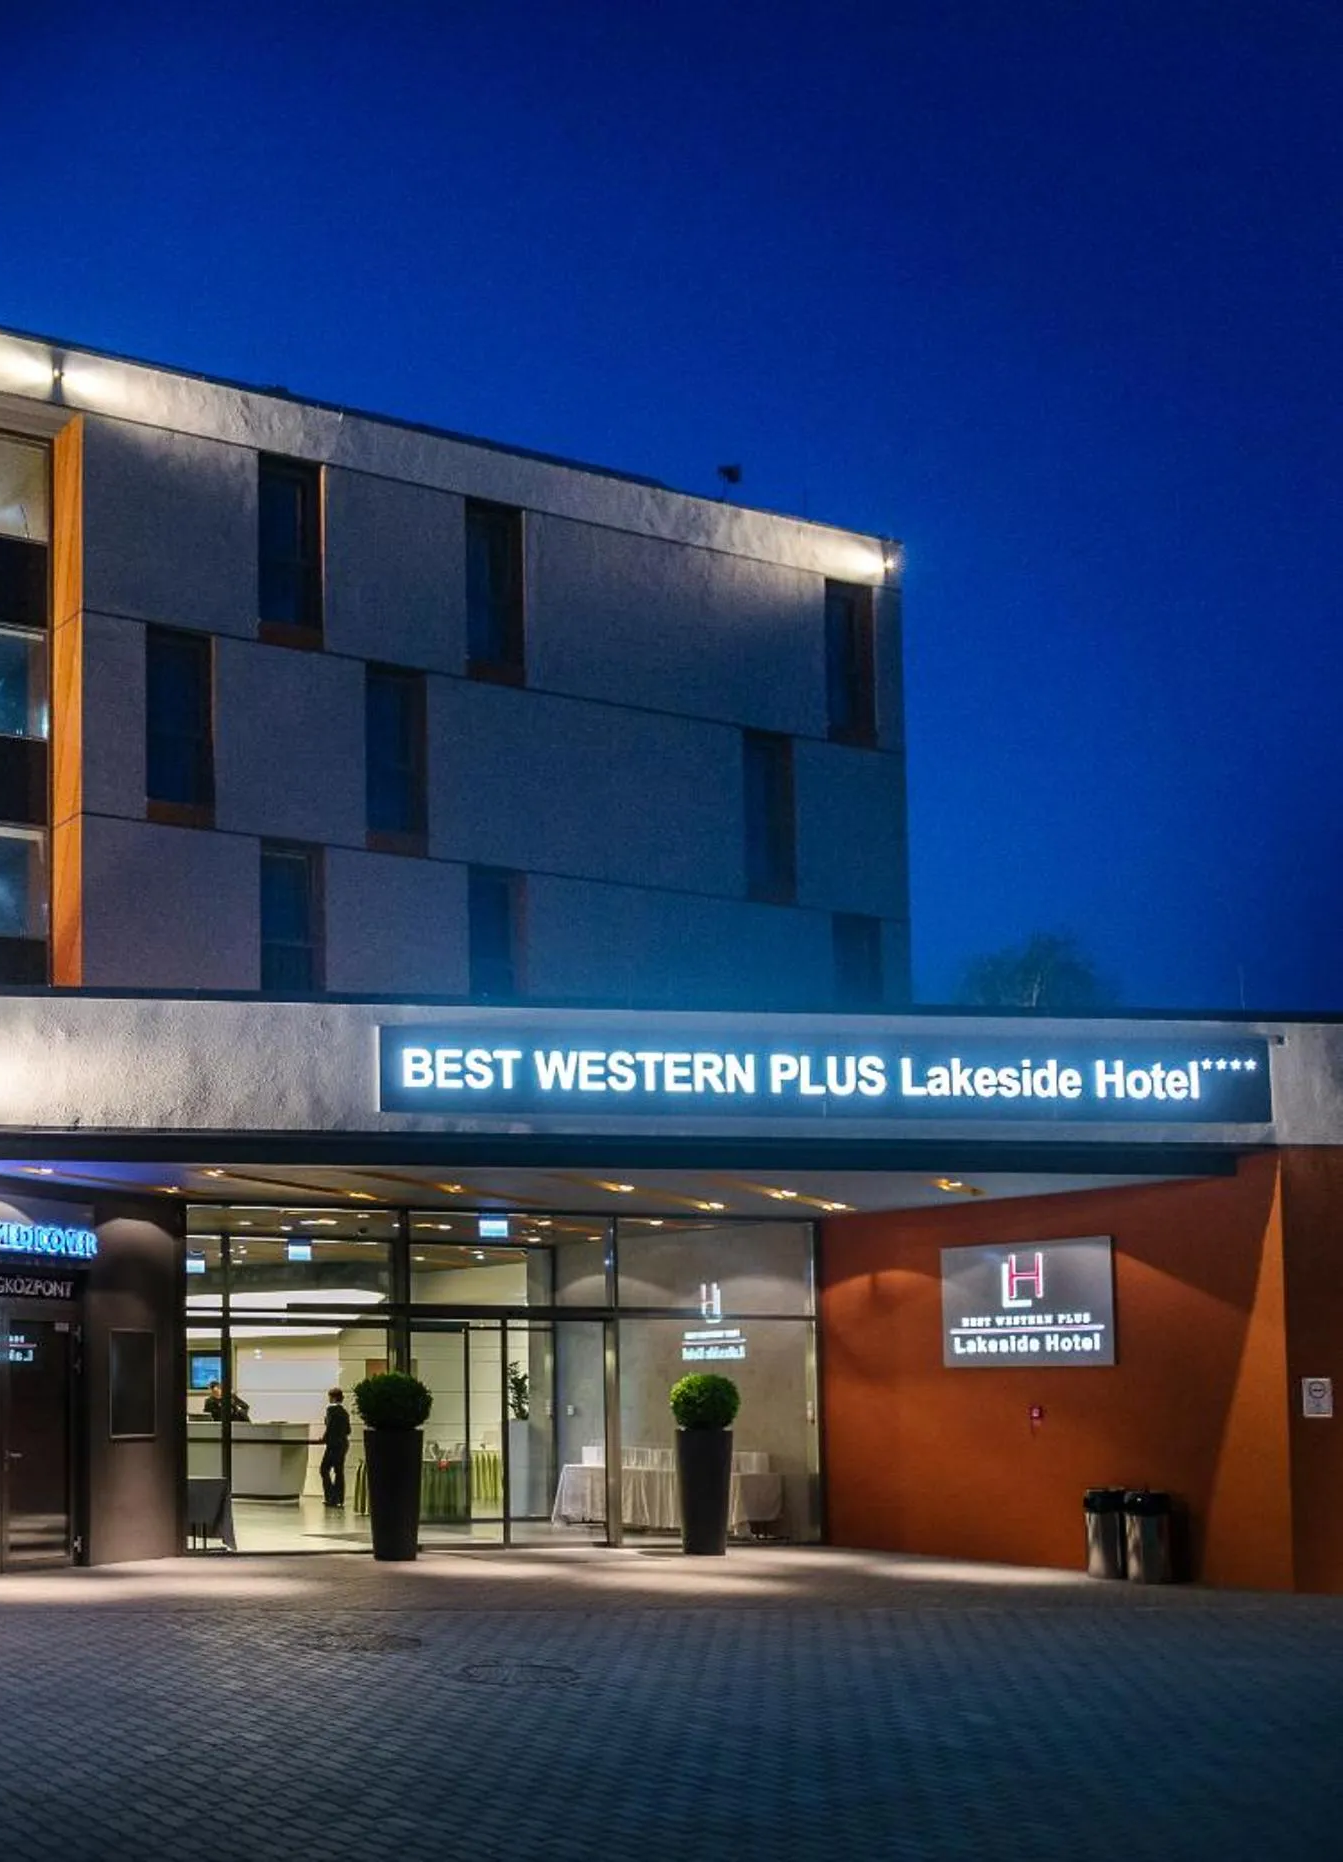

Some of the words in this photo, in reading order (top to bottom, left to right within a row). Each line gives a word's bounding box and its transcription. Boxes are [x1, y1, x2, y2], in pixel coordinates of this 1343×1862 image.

[401, 1047, 522, 1090] BEST
[533, 1050, 755, 1094] WESTERN
[769, 1053, 887, 1097] PLUS
[900, 1057, 1083, 1098] Lakeside
[1095, 1059, 1201, 1100] Hotel
[961, 1316, 992, 1328] BEST
[995, 1314, 1053, 1326] WESTERN
[1058, 1312, 1091, 1325] PLUS
[954, 1335, 1040, 1355] Lakeside
[1045, 1333, 1101, 1352] Hotel
